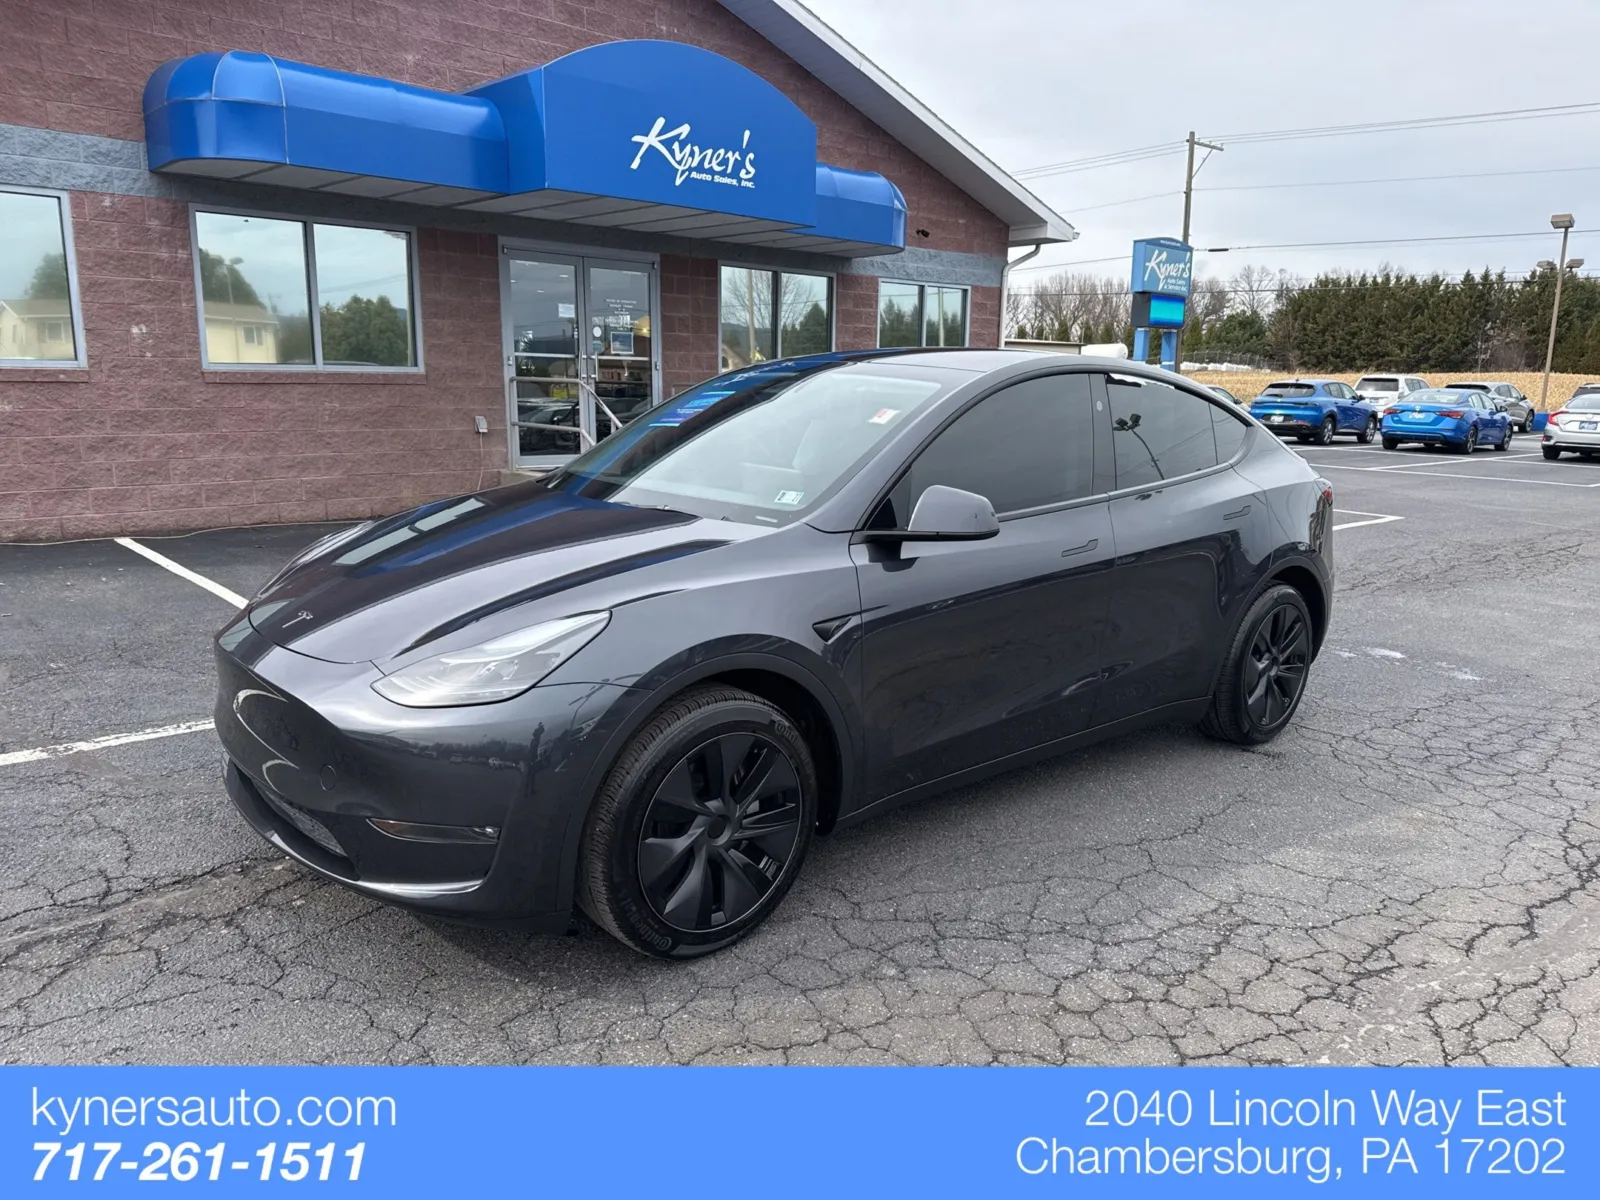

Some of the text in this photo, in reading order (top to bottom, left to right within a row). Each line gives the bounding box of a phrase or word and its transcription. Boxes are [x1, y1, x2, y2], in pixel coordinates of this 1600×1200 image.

[630, 116, 756, 187] Kyner's
[690, 171, 755, 188] Auto Sales, Inc.
[1144, 249, 1190, 291] Kyner's
